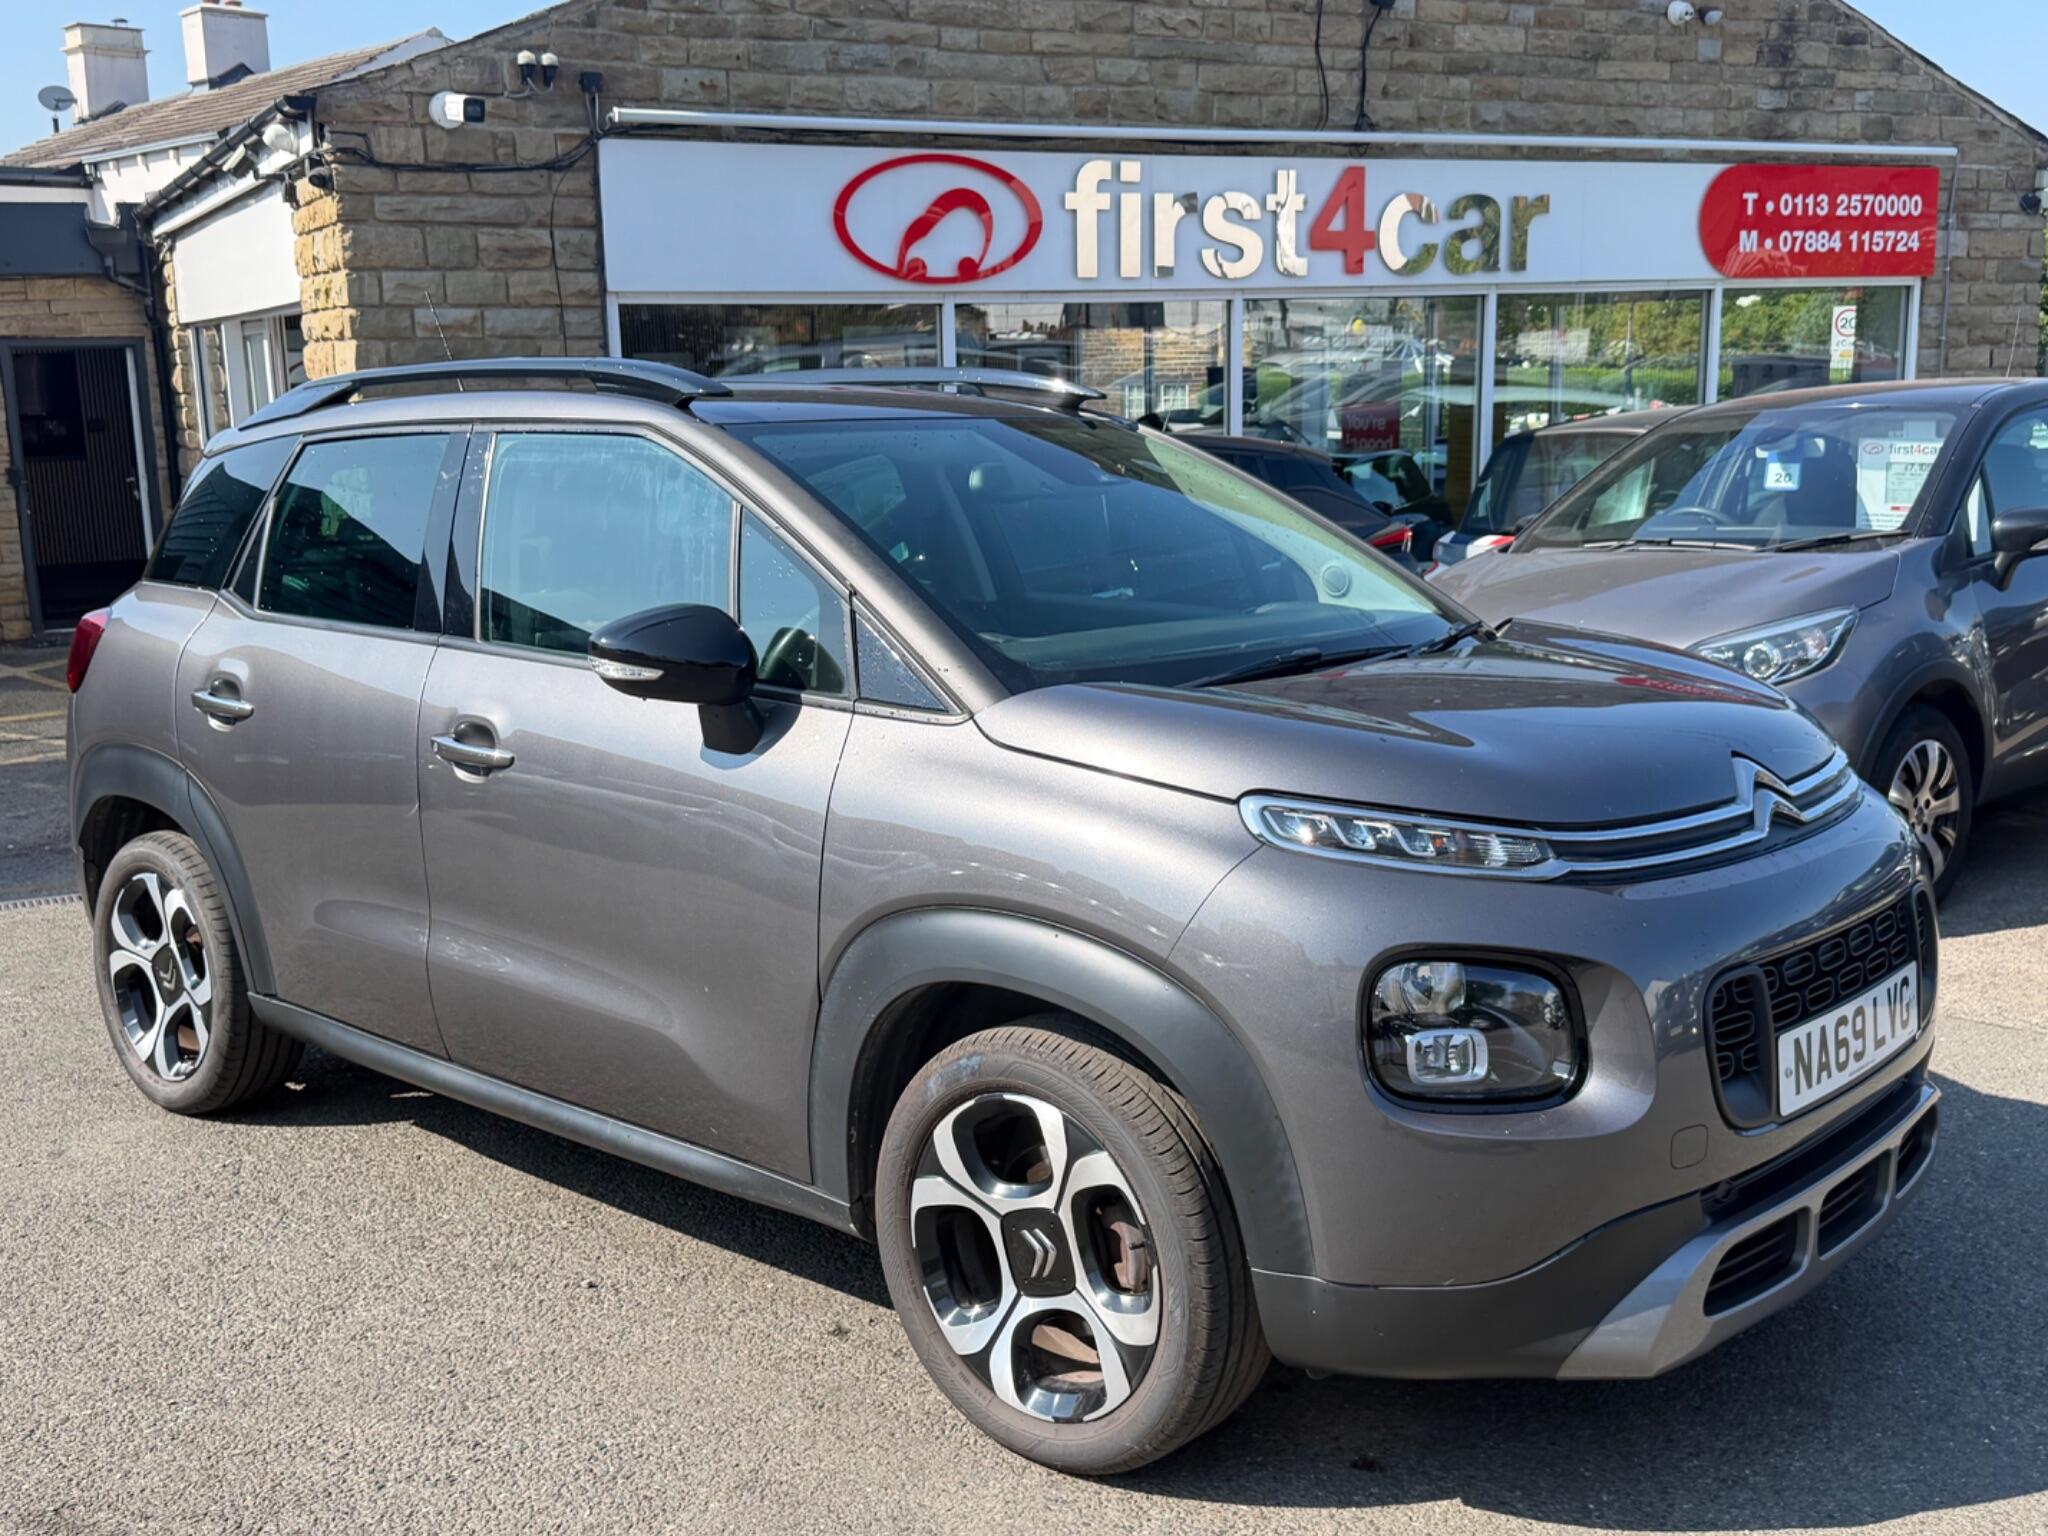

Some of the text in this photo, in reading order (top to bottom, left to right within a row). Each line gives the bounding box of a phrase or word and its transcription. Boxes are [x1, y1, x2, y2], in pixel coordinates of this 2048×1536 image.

[1743, 192, 1922, 217] T 0113 2570000
[1065, 159, 1550, 280] first4car
[1739, 230, 1920, 253] M 07884 115724
[1889, 444, 1939, 454] first4ca
[1794, 975, 1910, 1096] NA69 LVG
